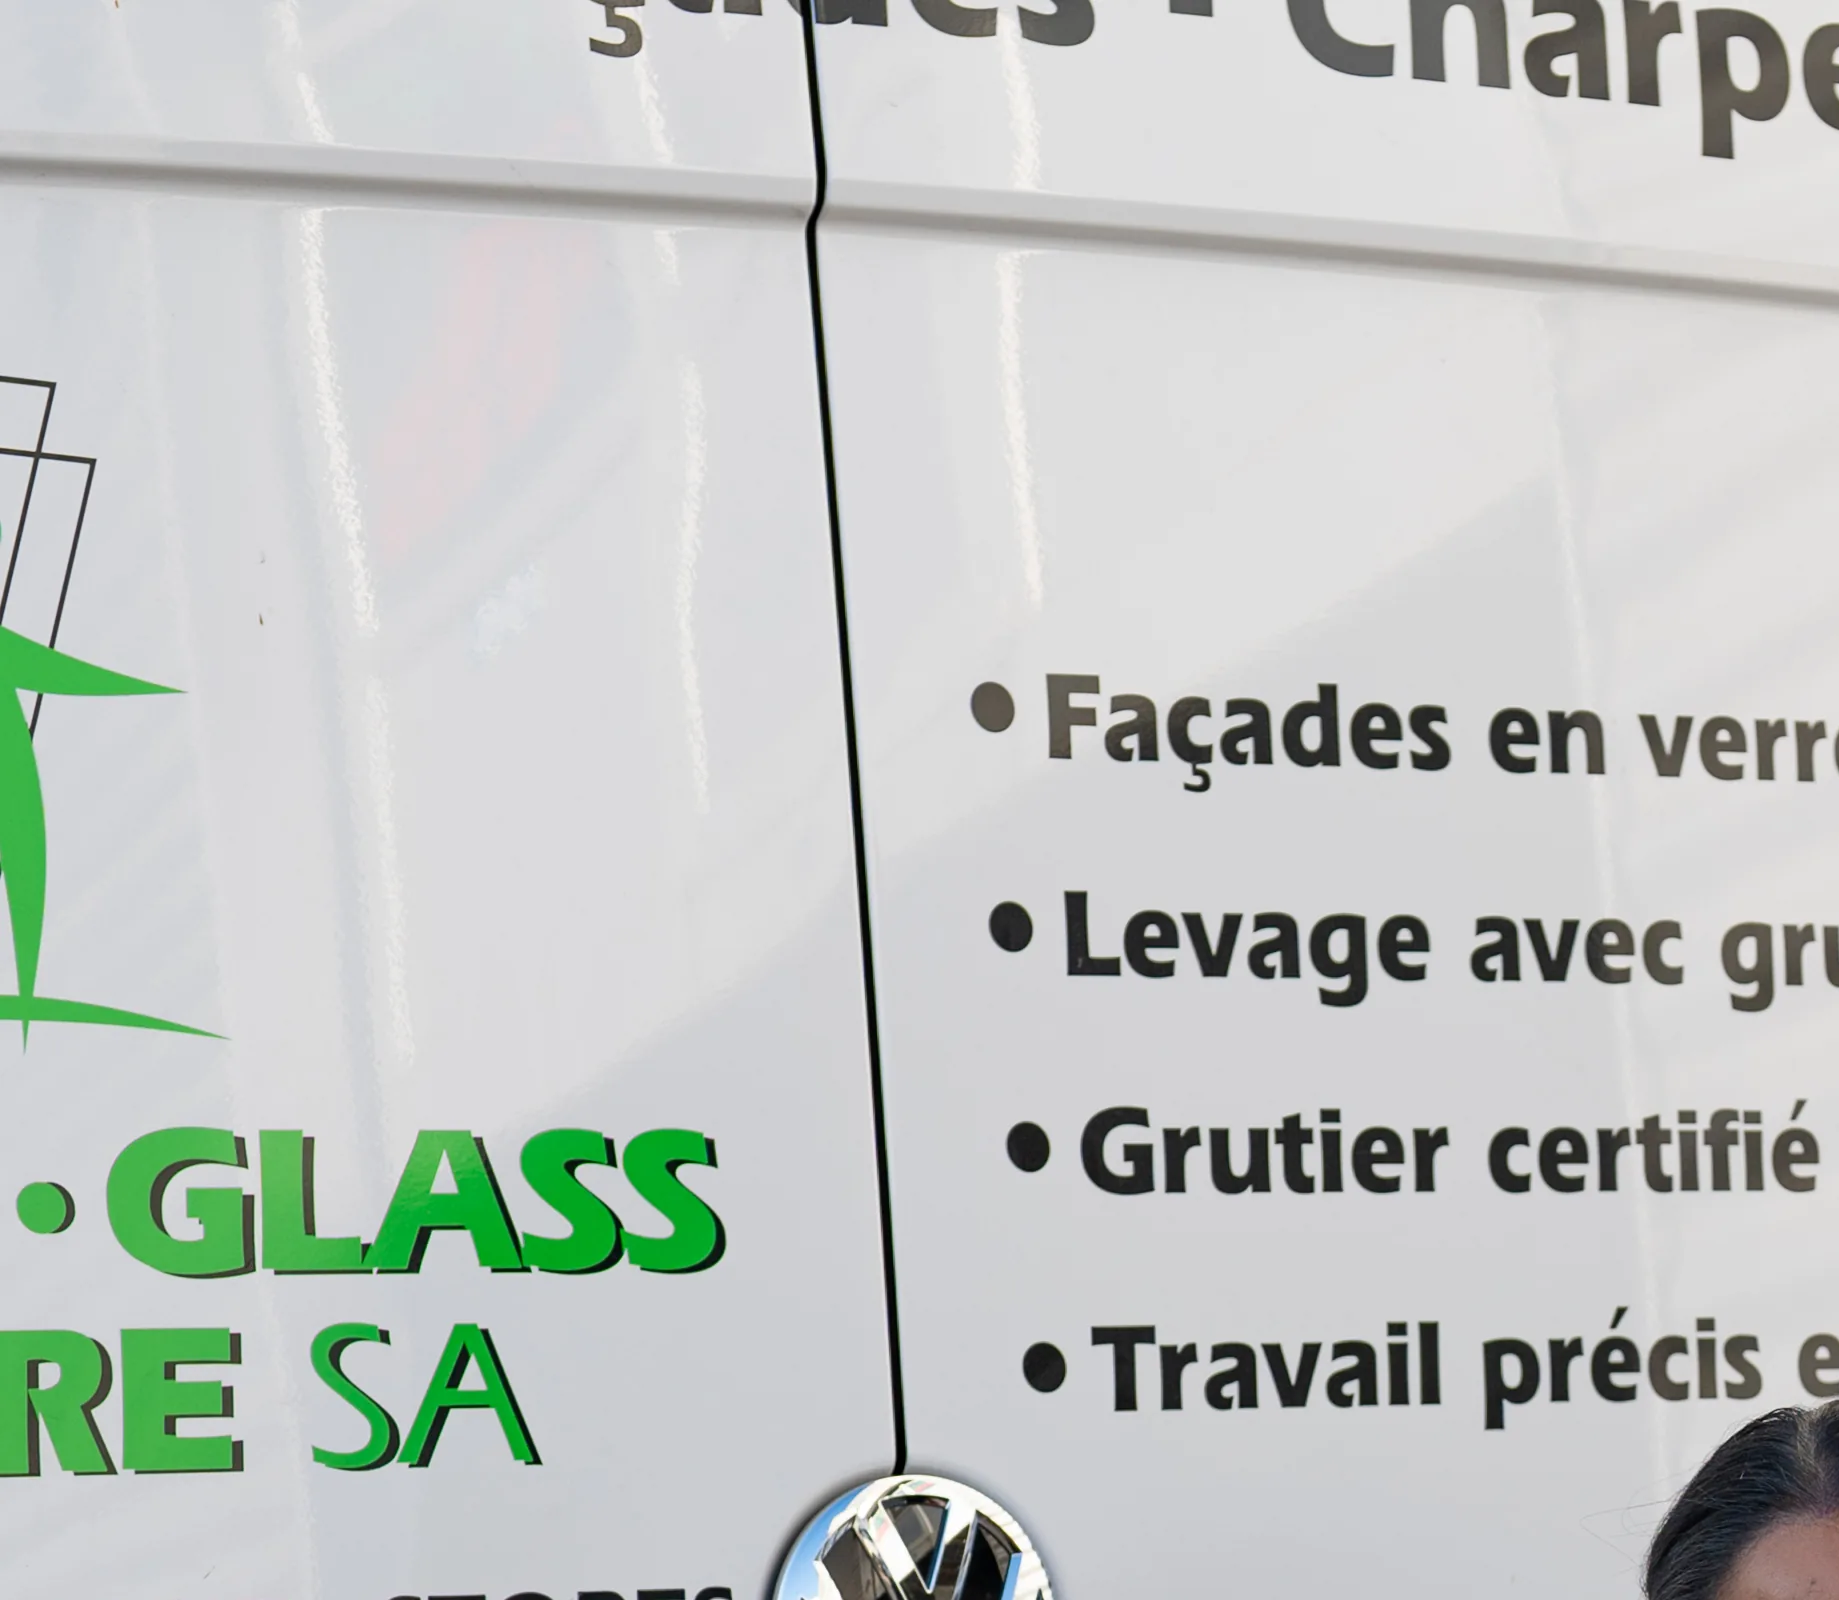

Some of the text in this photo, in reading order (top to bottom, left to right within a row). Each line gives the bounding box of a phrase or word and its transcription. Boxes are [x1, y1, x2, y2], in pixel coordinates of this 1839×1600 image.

[1046, 674, 1451, 793] Façades
[1489, 708, 1605, 775] en
[1064, 891, 1430, 1008] Levage
[1470, 916, 1683, 985] avec
[107, 1127, 726, 1279] GLASS
[1080, 1100, 1819, 1195] Grutier certifié
[0, 1323, 543, 1477] RE SA
[1091, 1321, 1441, 1412] Travail
[1483, 1306, 1763, 1430] précis
